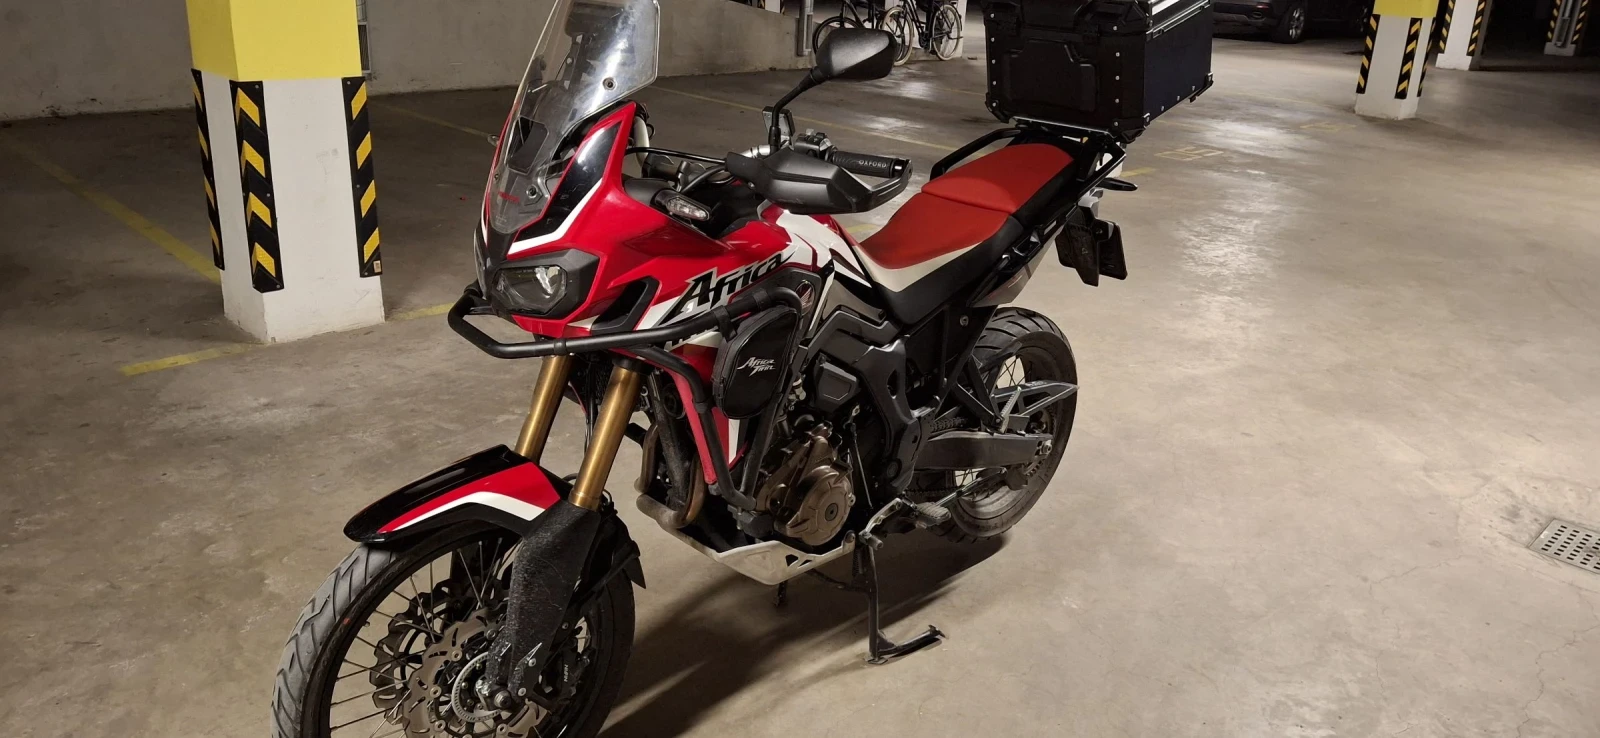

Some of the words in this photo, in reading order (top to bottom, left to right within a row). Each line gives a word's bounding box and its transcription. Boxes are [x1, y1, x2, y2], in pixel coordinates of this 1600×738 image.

[858, 160, 887, 168] OXFORD
[656, 251, 794, 326] Africa
[737, 357, 775, 369] Africa
